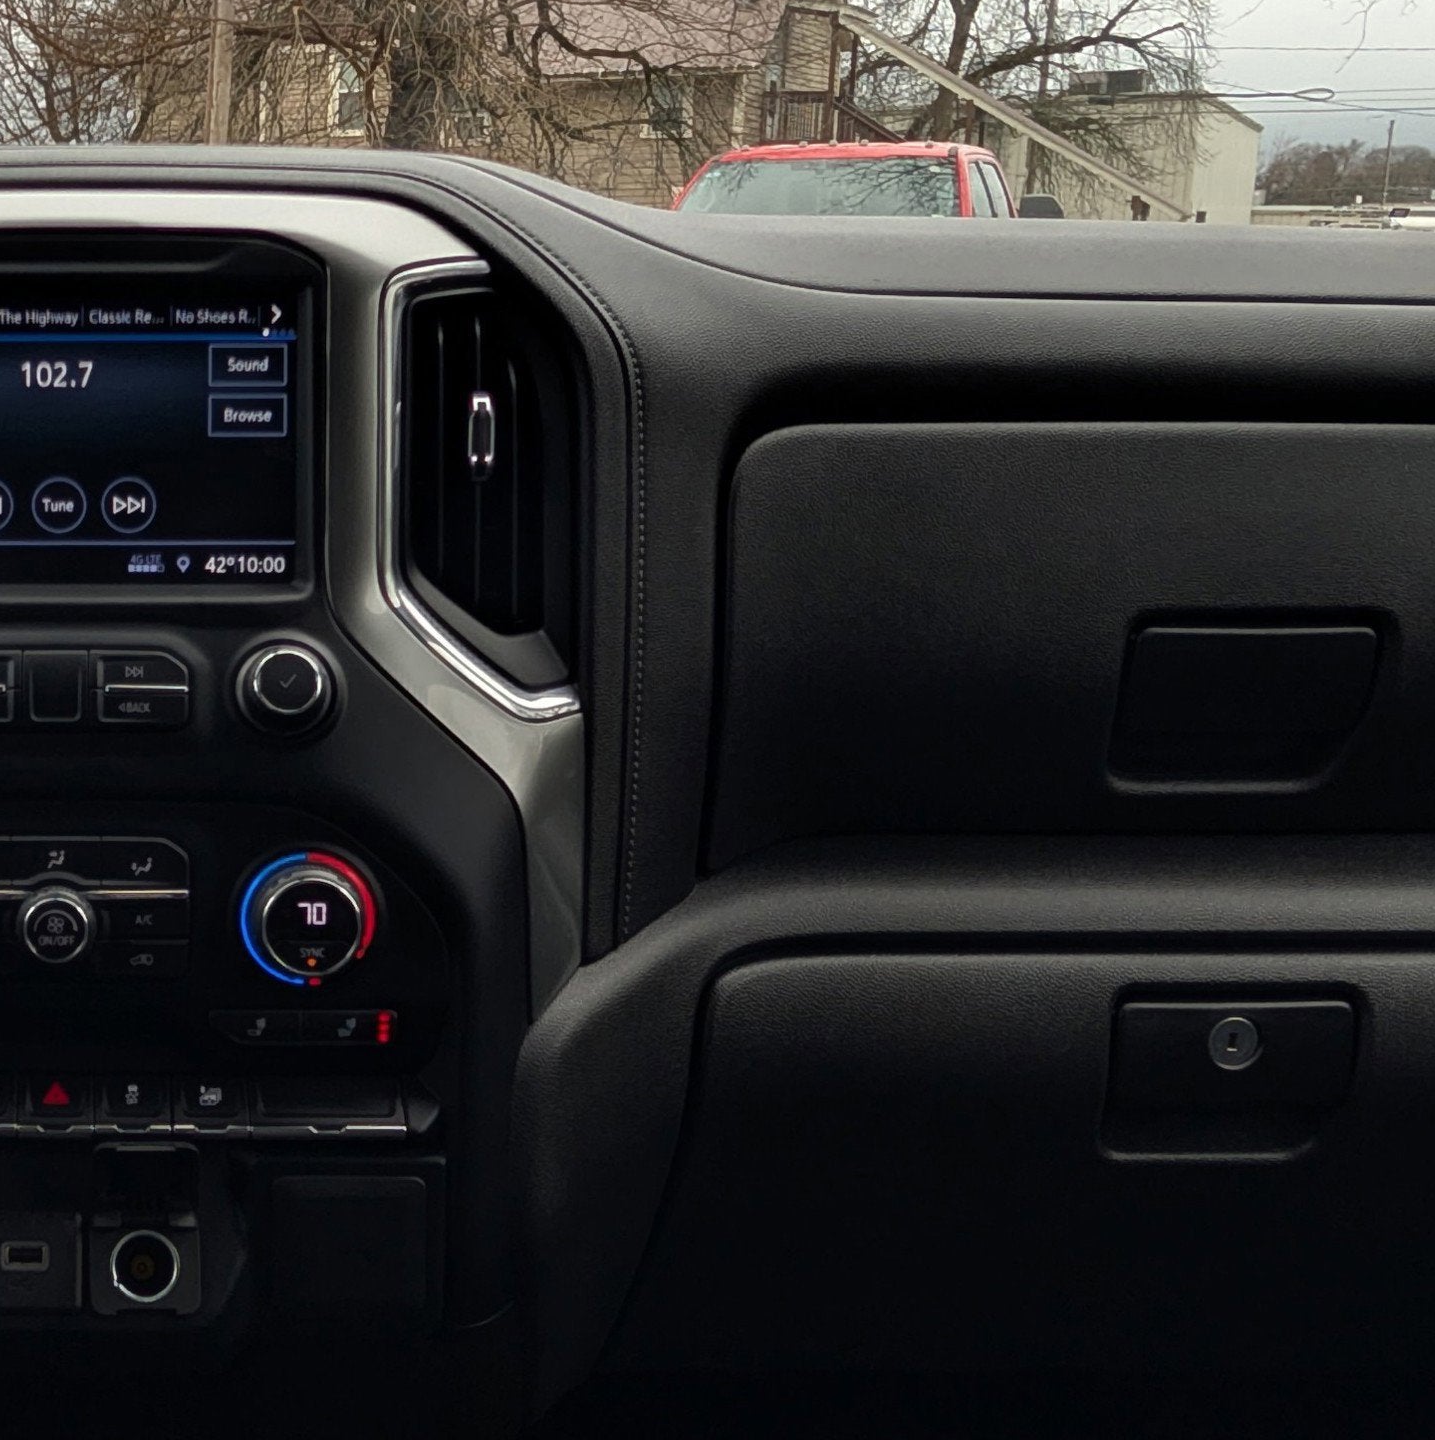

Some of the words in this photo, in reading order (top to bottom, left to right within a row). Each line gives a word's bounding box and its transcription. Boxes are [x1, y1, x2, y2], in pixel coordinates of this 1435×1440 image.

[25, 308, 79, 329] Highway
[89, 308, 131, 325] Classic
[175, 308, 195, 325] No
[197, 308, 237, 325] Shoes
[227, 356, 270, 373] Sound
[21, 360, 93, 389] 102.7
[223, 406, 273, 424] Browse
[41, 496, 75, 513] Tune
[237, 555, 287, 574] 10:00
[297, 902, 327, 926] 70
[37, 934, 75, 947] ON/OFF
[299, 946, 325, 958] SYNC
